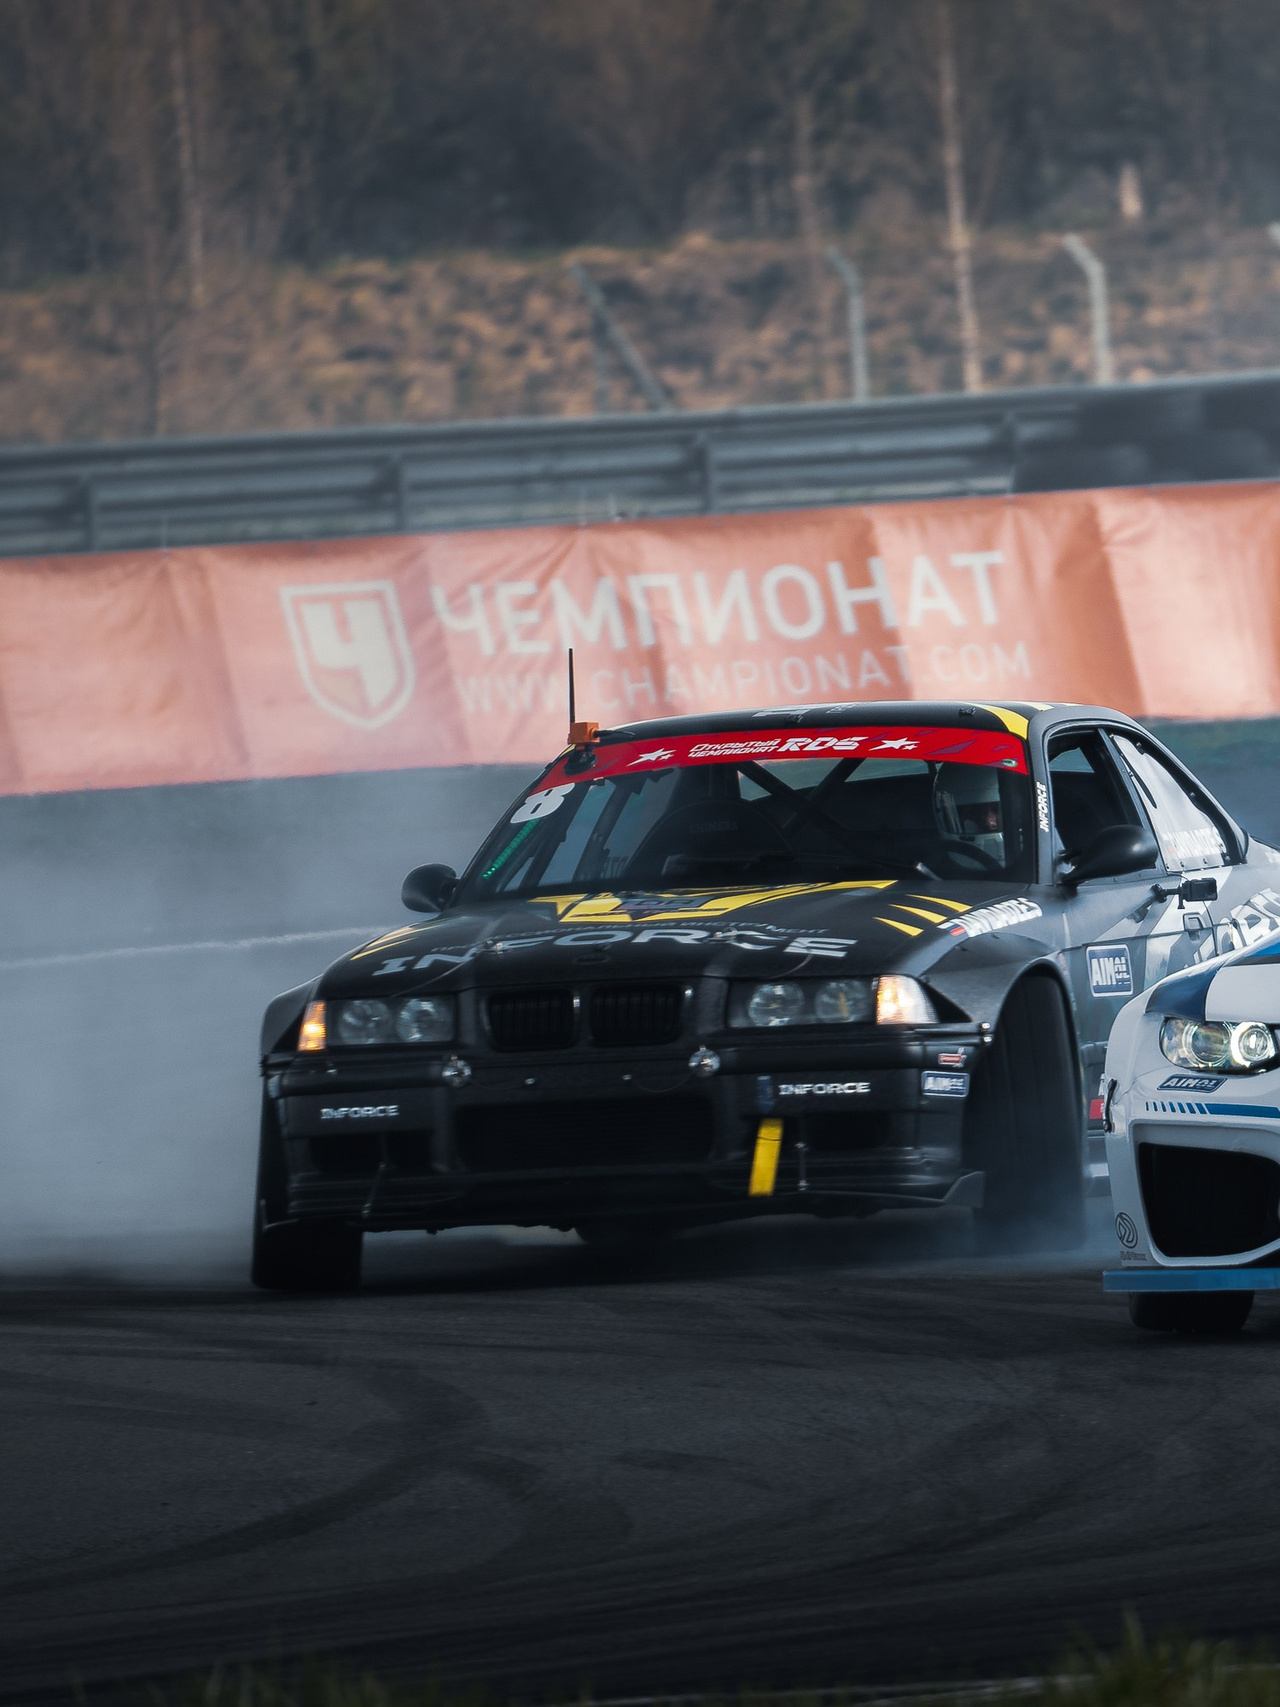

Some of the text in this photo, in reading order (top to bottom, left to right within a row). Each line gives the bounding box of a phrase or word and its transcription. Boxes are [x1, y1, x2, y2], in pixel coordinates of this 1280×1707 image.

[428, 550, 1006, 657] ЧЕМПИОНАТ
[776, 736, 870, 752] RDS
[509, 782, 576, 824] 8
[1036, 781, 1050, 833] INFORCE
[371, 929, 859, 976] INFORCE
[778, 1081, 872, 1095] INFORCE
[320, 1104, 400, 1119] INFORCE
